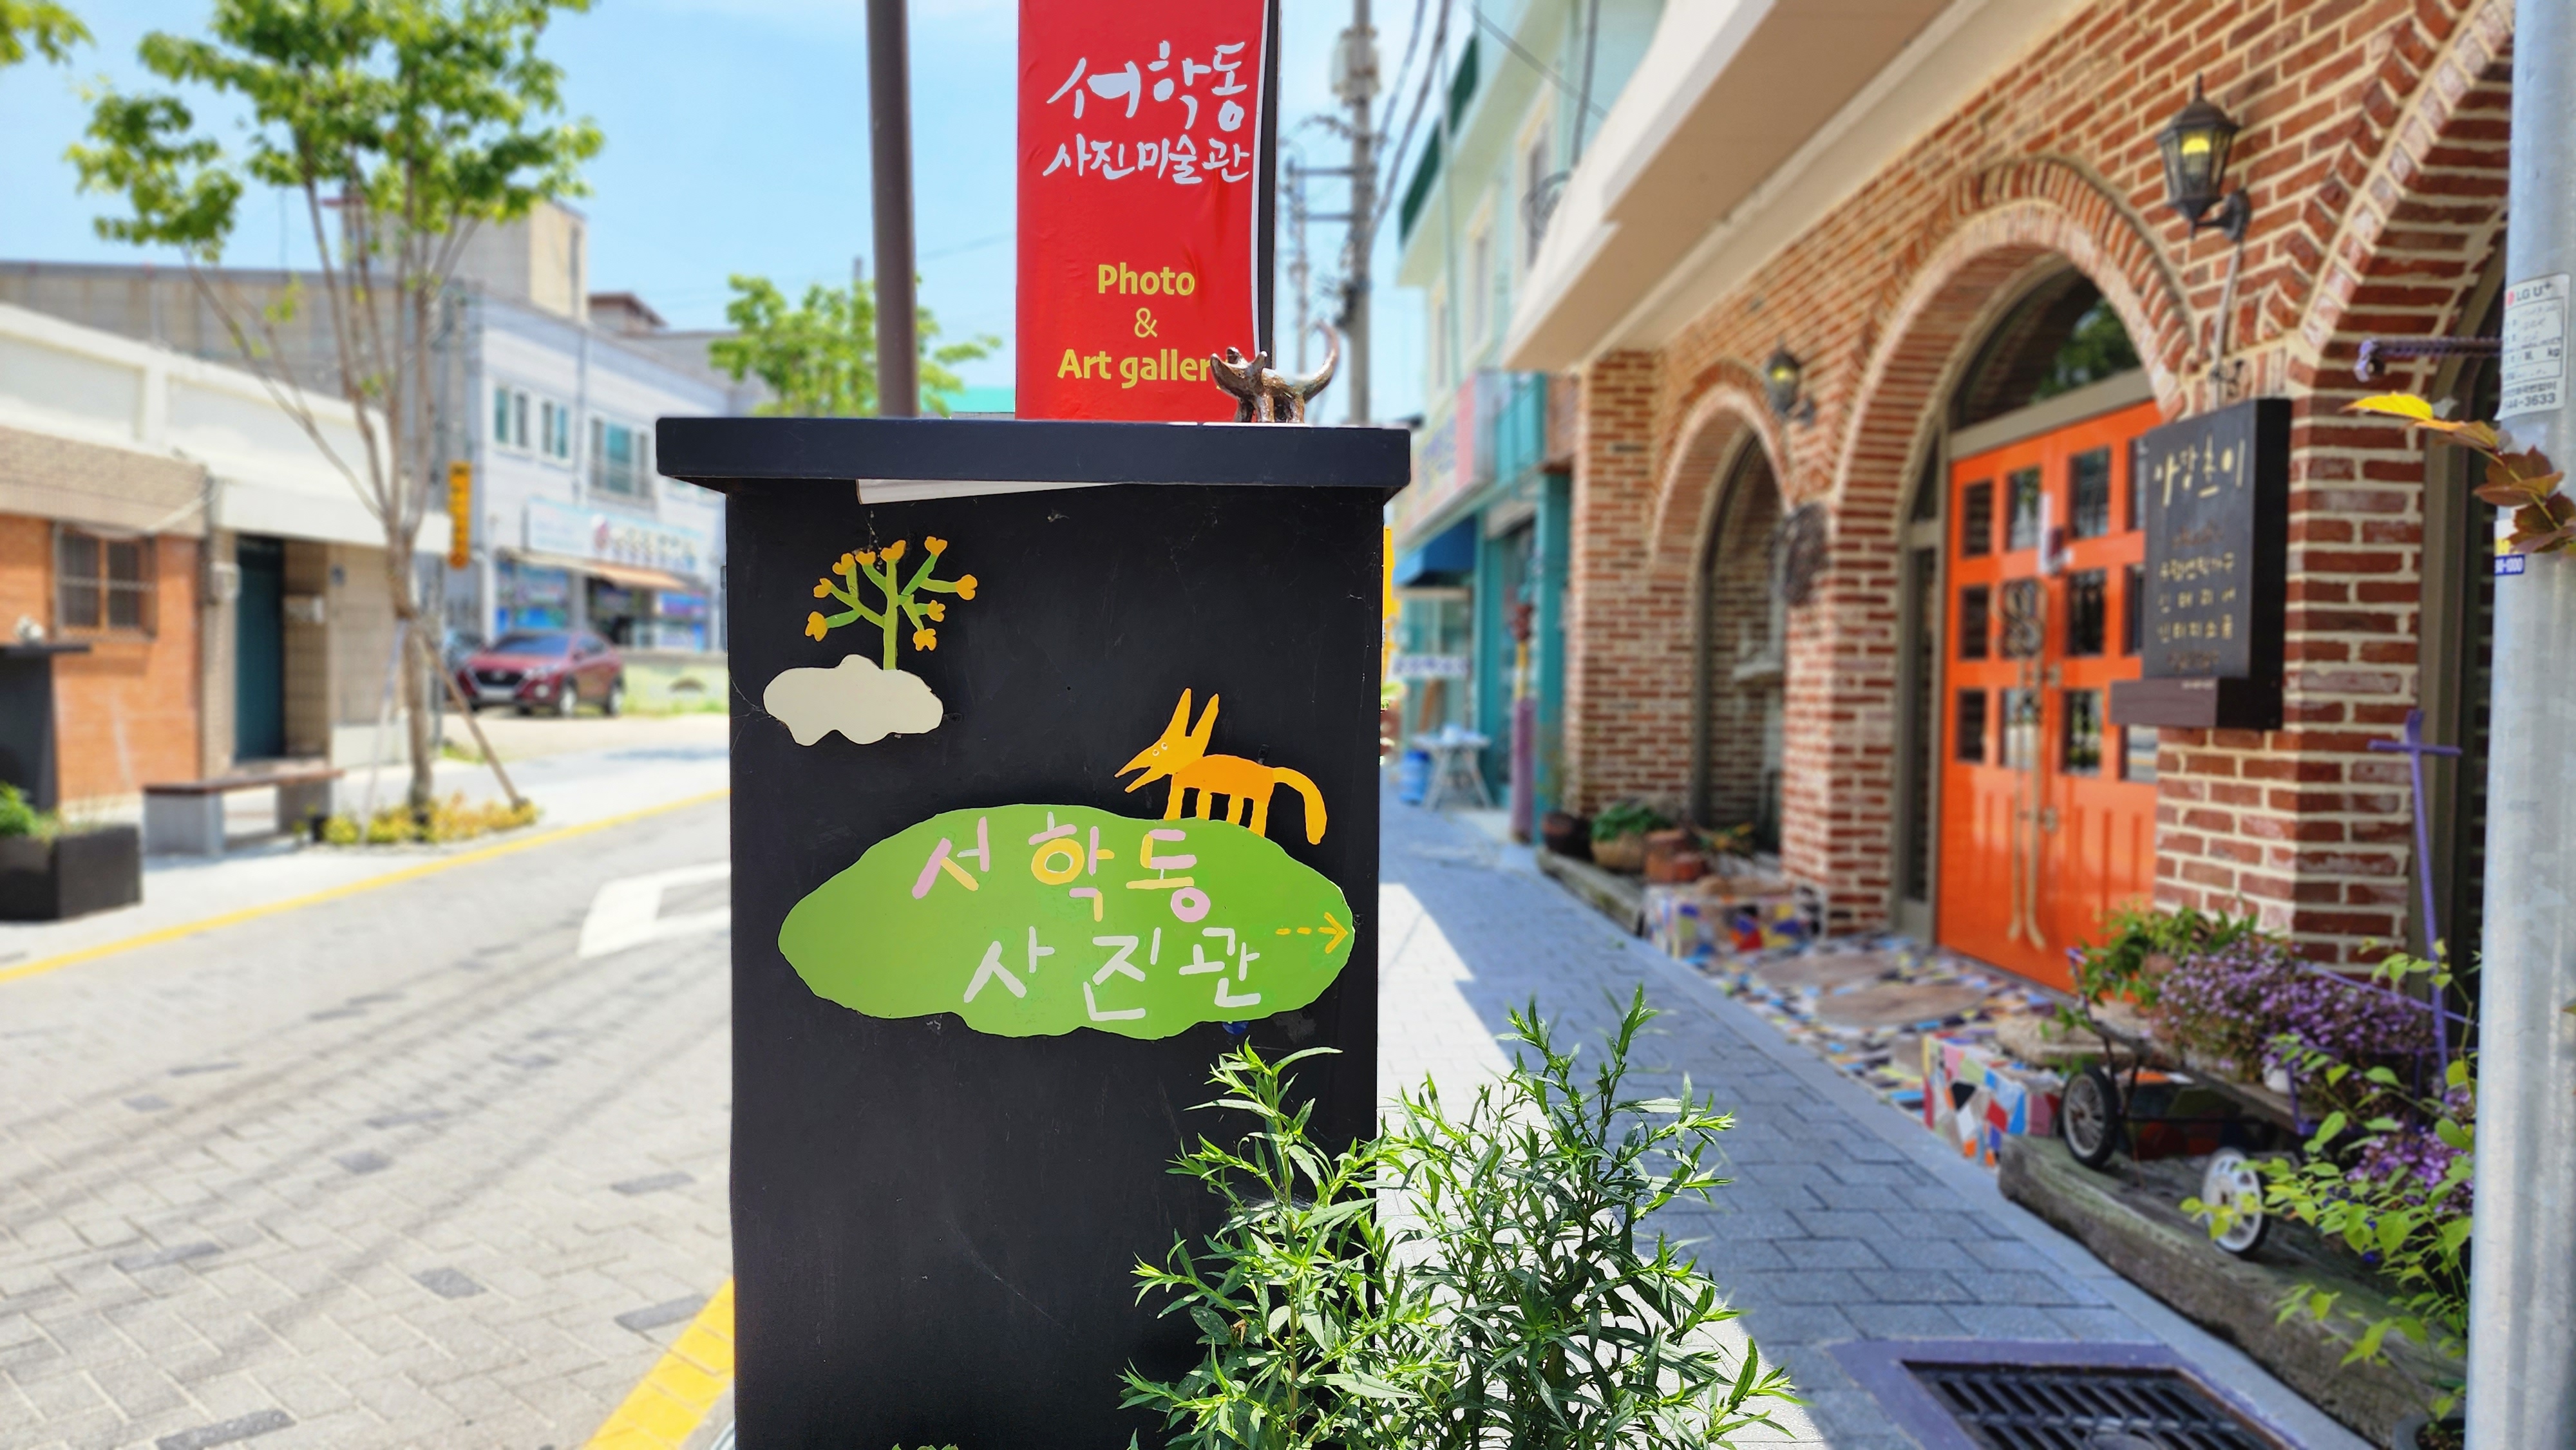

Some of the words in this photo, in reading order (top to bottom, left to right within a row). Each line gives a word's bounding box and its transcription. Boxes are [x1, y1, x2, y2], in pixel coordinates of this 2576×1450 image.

[1046, 40, 1247, 132] 서학동
[1043, 133, 1250, 185] 사진미술관
[1097, 262, 1196, 296] Photo
[1133, 307, 1159, 338] &
[1057, 348, 1112, 381] Art
[1119, 348, 1228, 391] galler
[912, 811, 1211, 923] 서학동
[963, 926, 1262, 1022] 사진관
